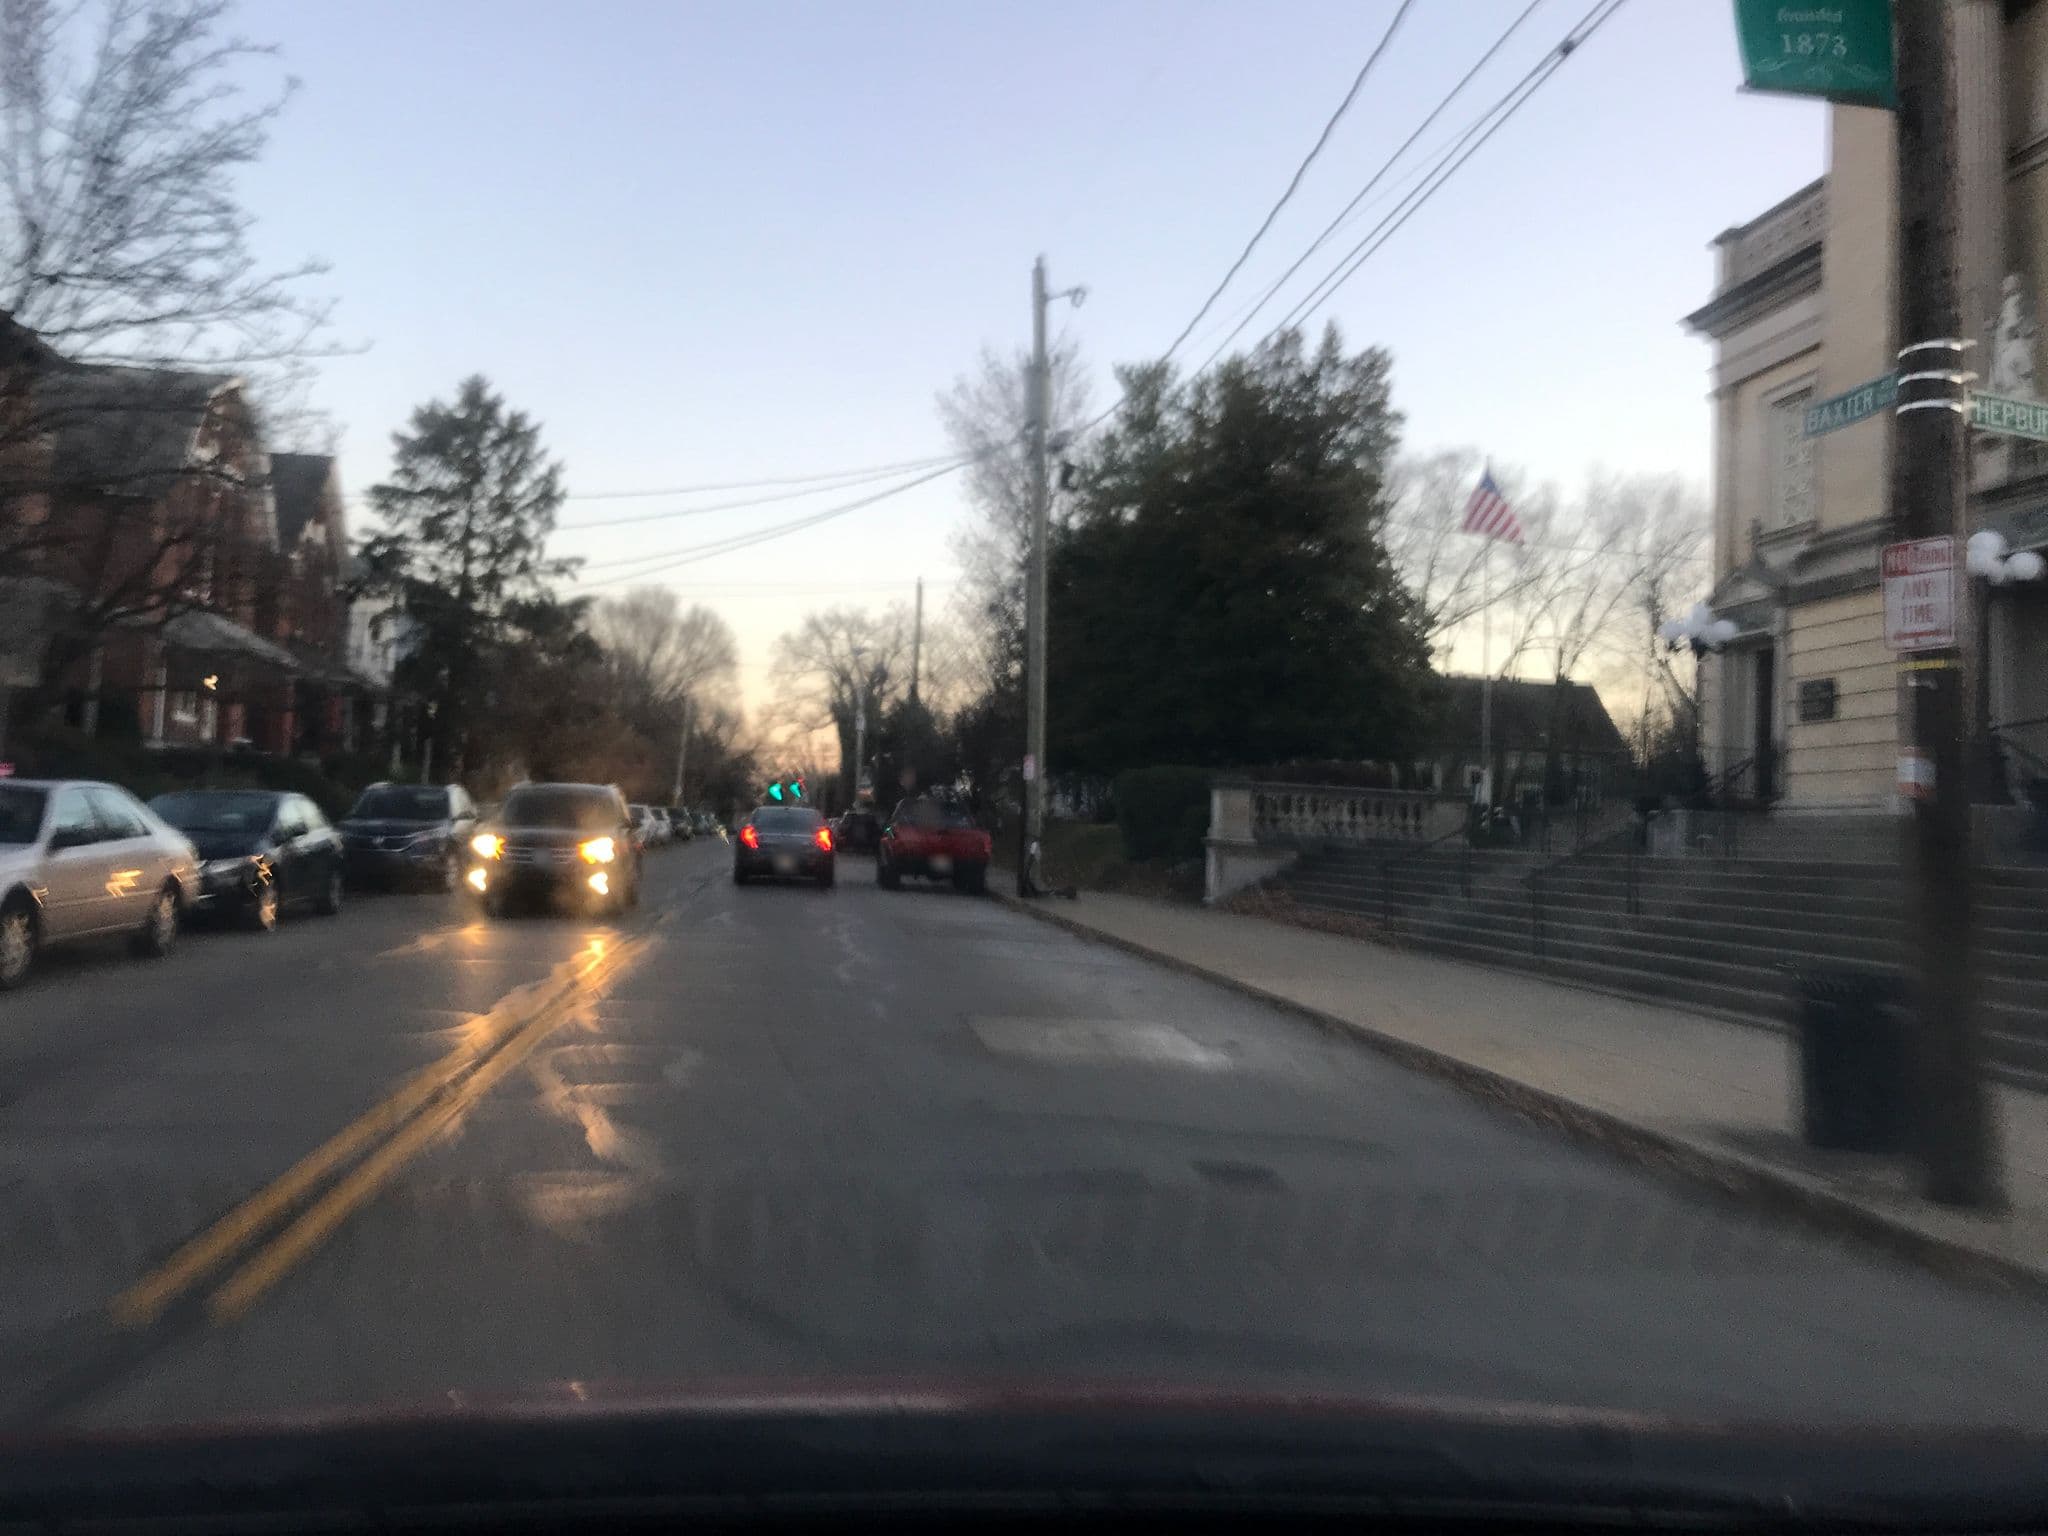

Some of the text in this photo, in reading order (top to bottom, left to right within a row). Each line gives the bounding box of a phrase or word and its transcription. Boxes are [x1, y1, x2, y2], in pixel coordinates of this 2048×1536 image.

[1782, 33, 1848, 57] 1873
[1807, 388, 1873, 433] BAXTER
[1902, 578, 1932, 600] ANY
[1902, 603, 1935, 626] TIME
